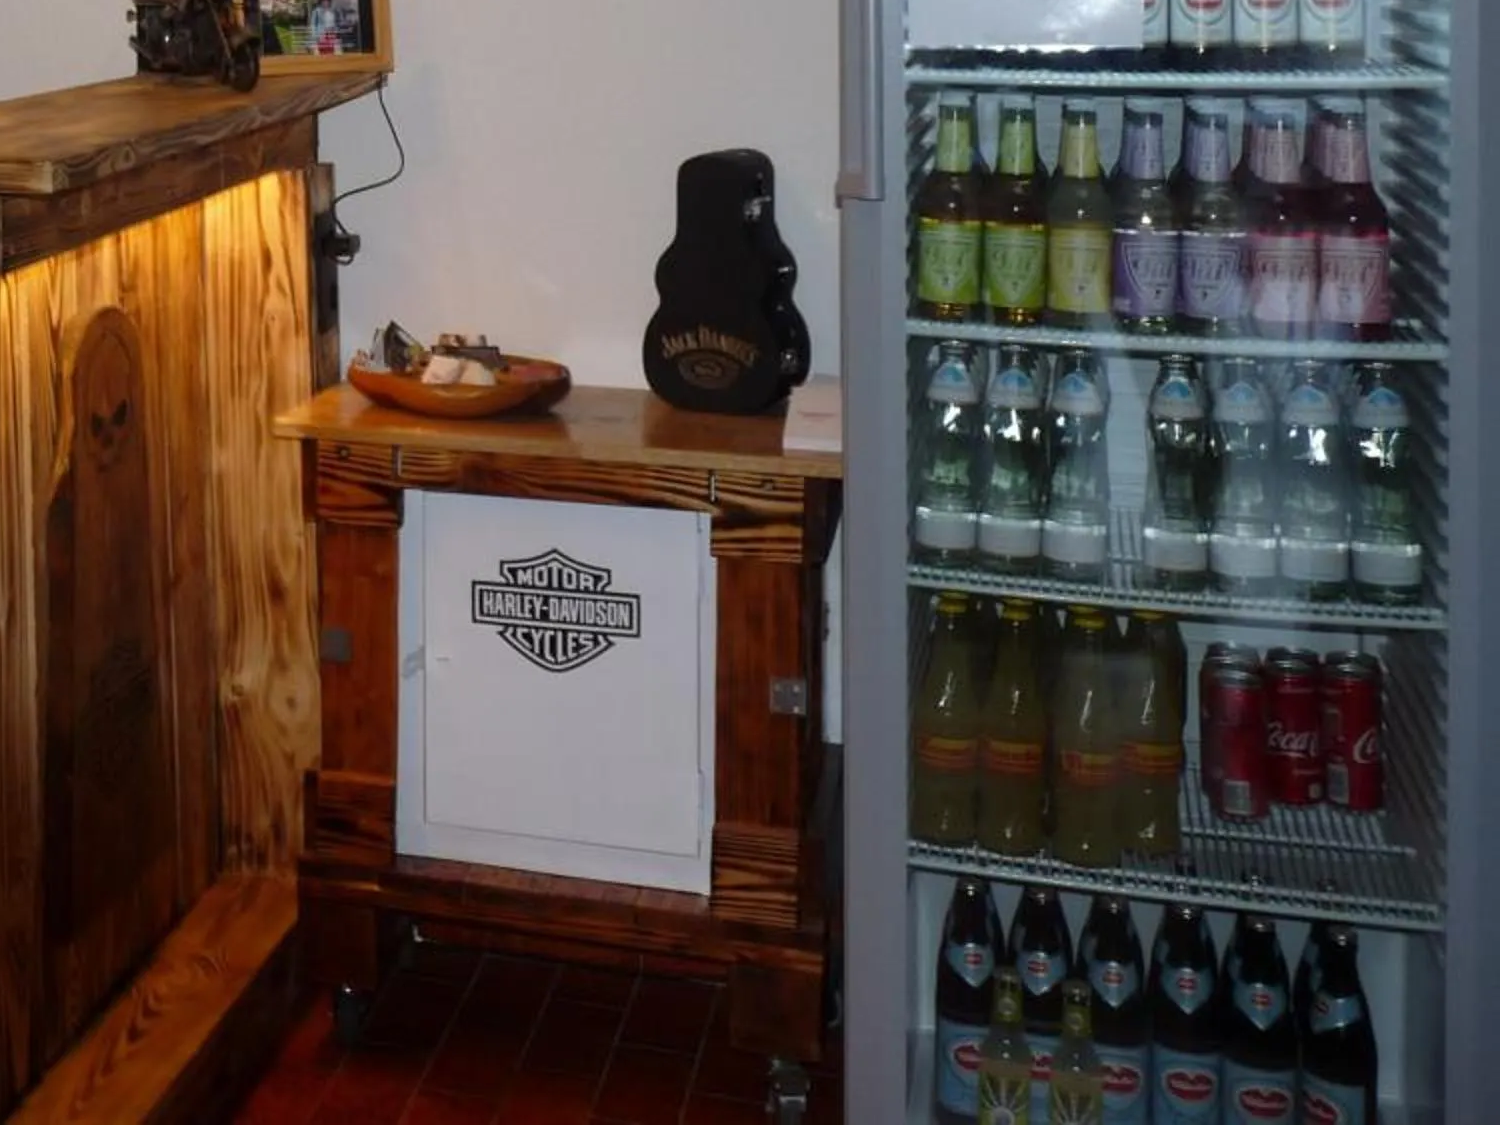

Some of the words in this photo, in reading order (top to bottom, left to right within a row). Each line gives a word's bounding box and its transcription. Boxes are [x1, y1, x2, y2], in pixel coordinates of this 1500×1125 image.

[516, 562, 595, 592] MOTOR
[482, 590, 630, 628] HARLEY-DAVIDSON
[516, 627, 596, 663] CYCLES
